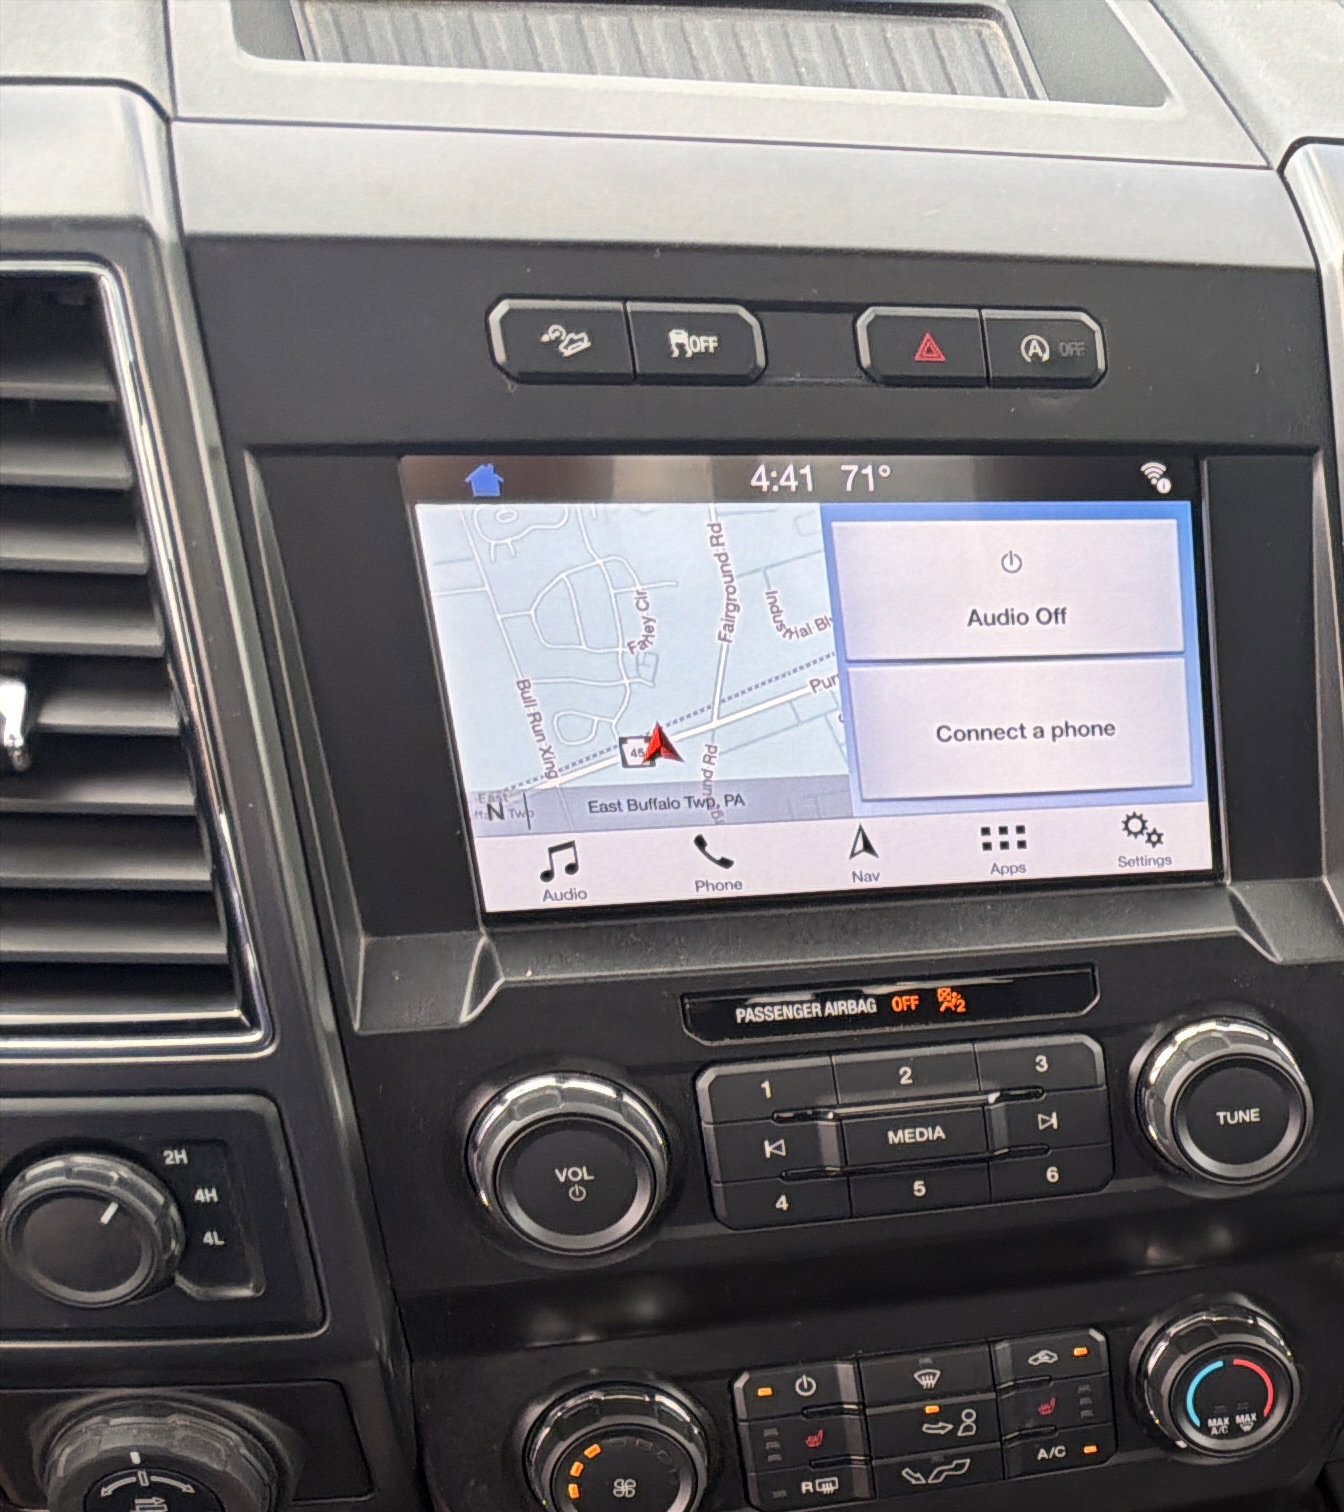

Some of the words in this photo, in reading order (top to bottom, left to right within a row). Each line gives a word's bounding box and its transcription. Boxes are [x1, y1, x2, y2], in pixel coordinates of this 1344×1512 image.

[690, 335, 718, 352] OFF
[750, 465, 815, 493] 4:41
[840, 464, 892, 492] 71°
[707, 522, 726, 548] Rd
[634, 590, 650, 612] Cir
[713, 552, 741, 643] Fairground
[966, 606, 1028, 627] Audio
[1034, 606, 1068, 626] Off
[516, 679, 538, 708] Bull
[527, 712, 546, 742] Run
[539, 745, 559, 779] Xing
[935, 722, 1026, 743] Connect
[1029, 727, 1045, 740] a
[1050, 718, 1117, 743] phone
[487, 803, 504, 821] N
[588, 800, 623, 814] East
[627, 793, 681, 812] Buffalo
[724, 793, 746, 807] PA
[989, 859, 1027, 876] Apps
[1117, 851, 1173, 869] Settings
[851, 868, 881, 883] Nav
[694, 878, 743, 892] Phone
[542, 887, 587, 902] Audio
[736, 1001, 821, 1024] PASSENGER
[824, 997, 878, 1017] AIRBAG
[891, 995, 919, 1012] OFF
[1035, 1055, 1049, 1072] 3
[899, 1067, 913, 1084] 2
[761, 1081, 772, 1098] 1
[1216, 1107, 1261, 1127] TUNE
[888, 1124, 946, 1145] MEDIA
[163, 1150, 187, 1165] 2H
[554, 1165, 594, 1185] VOL
[1045, 1166, 1060, 1183] 6
[195, 1188, 218, 1203] 4H
[913, 1180, 927, 1197] 5
[775, 1194, 789, 1211] 4
[203, 1231, 225, 1246] 4L
[1207, 1416, 1230, 1427] MAX
[1235, 1412, 1257, 1424] MAX
[1211, 1426, 1229, 1436] A/C
[1037, 1446, 1067, 1460] A/C
[801, 1481, 814, 1494] R
